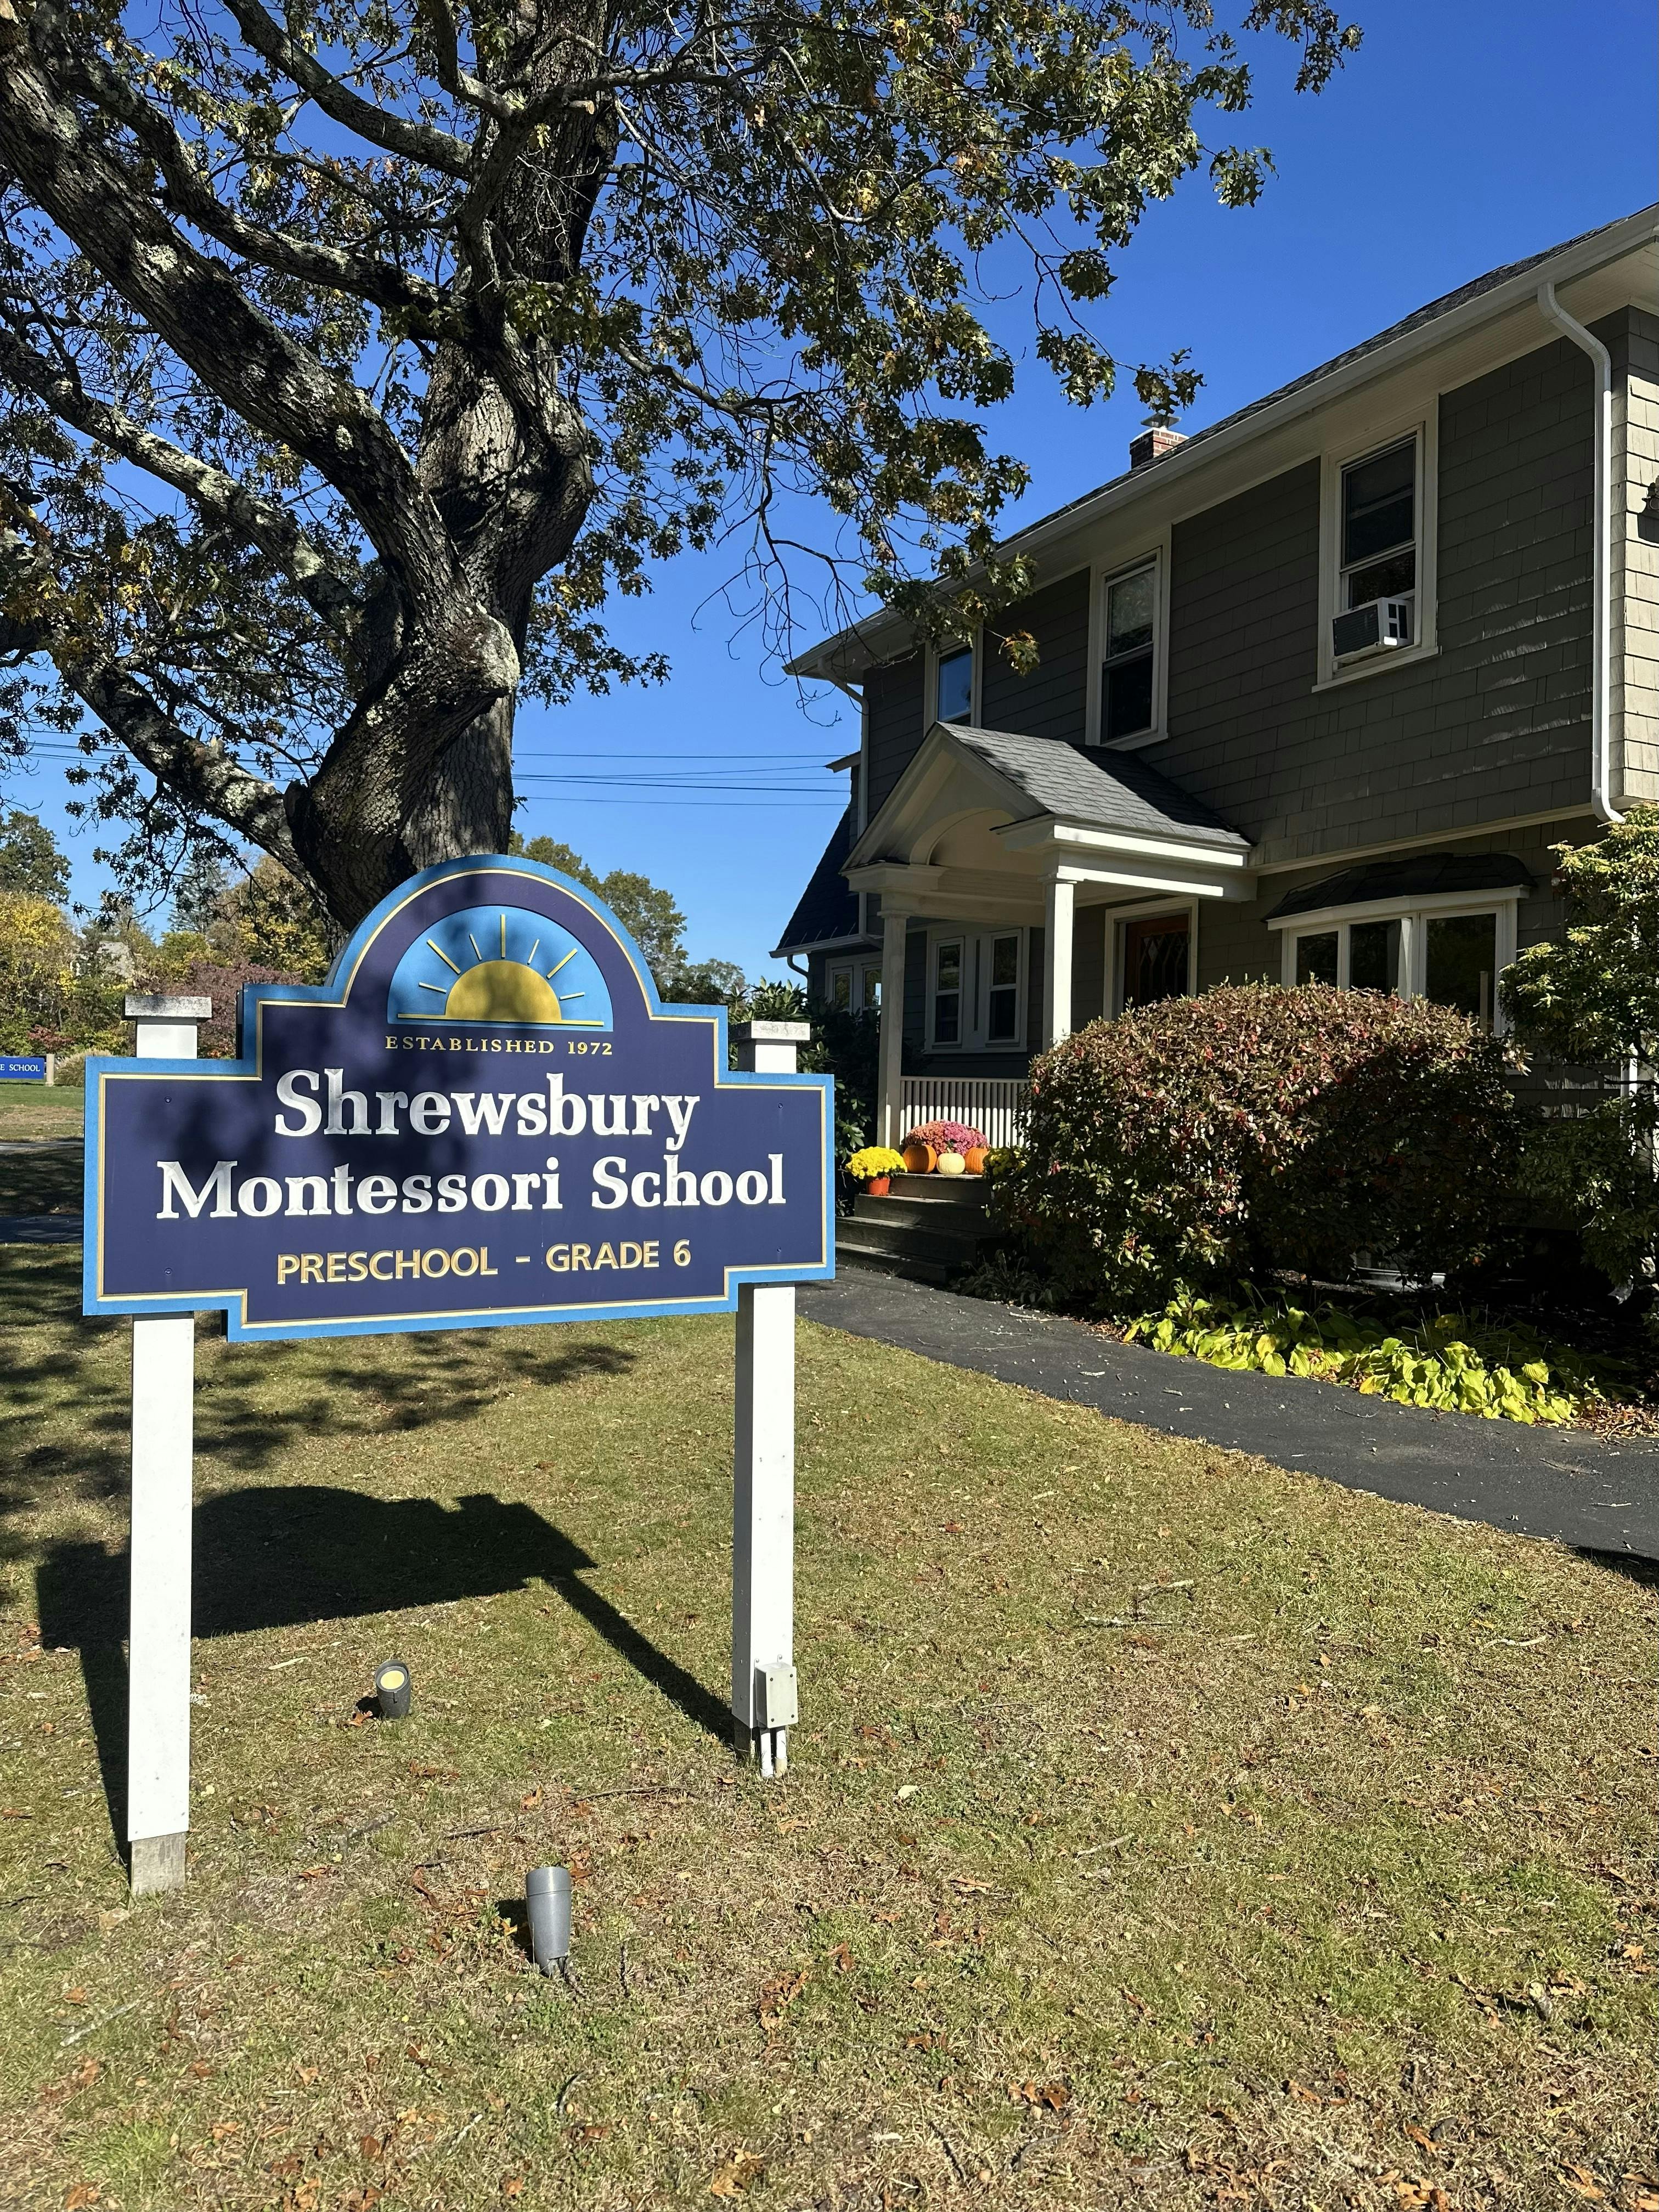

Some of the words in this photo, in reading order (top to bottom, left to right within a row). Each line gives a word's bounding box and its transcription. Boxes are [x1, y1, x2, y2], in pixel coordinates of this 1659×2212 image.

[9, 1064, 41, 1072] SCHOOL
[385, 1036, 555, 1054] ESTABLISHED
[568, 1041, 613, 1056] 1972
[275, 1068, 701, 1152] Shrewsbury
[156, 1157, 563, 1219] Montessori
[591, 1154, 787, 1210] School
[277, 1246, 499, 1285] PRESCHOOL
[545, 1239, 660, 1273] GRADE
[673, 1239, 692, 1267] 6
